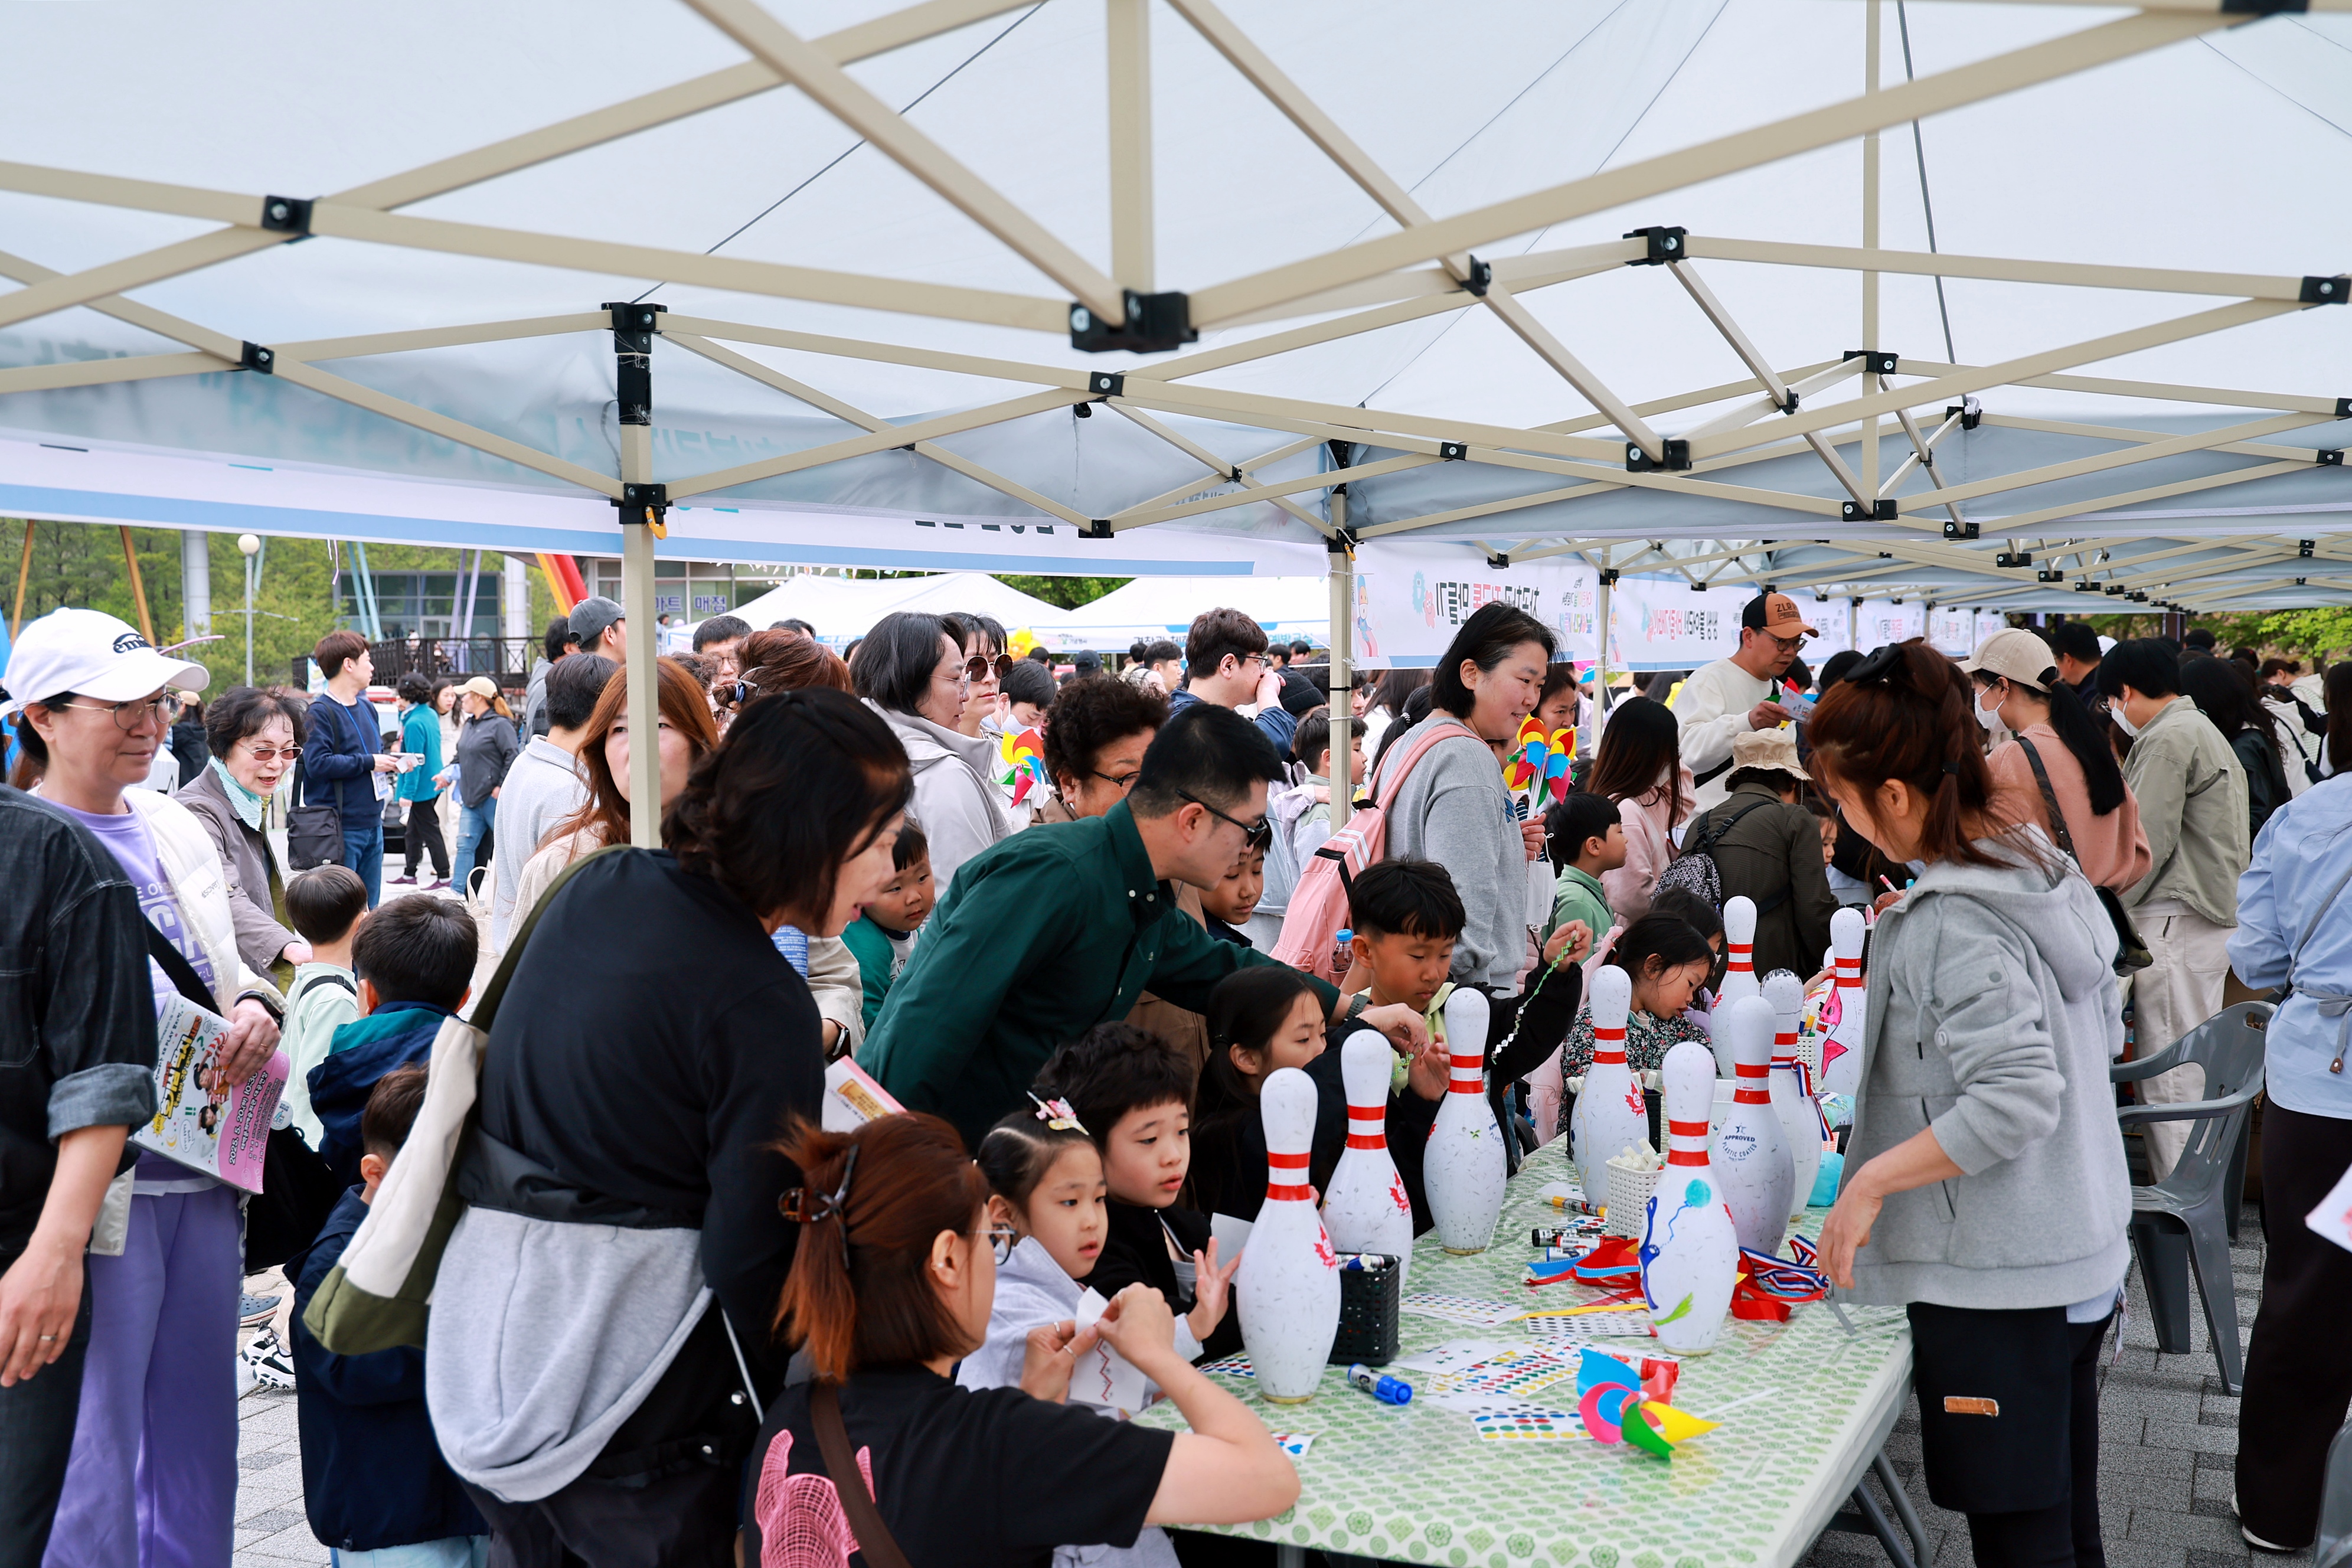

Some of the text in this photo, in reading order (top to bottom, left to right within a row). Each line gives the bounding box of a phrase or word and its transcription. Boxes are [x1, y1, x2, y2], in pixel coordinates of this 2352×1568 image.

[694, 596, 726, 613] 매점
[161, 1047, 167, 1056] XR
[165, 1030, 174, 1046] PLAY
[253, 1070, 268, 1098] 대공연장
[228, 1136, 239, 1165] 2025.
[234, 1124, 241, 1135] 5.
[1722, 1141, 1757, 1157] PLASTIC COATED
